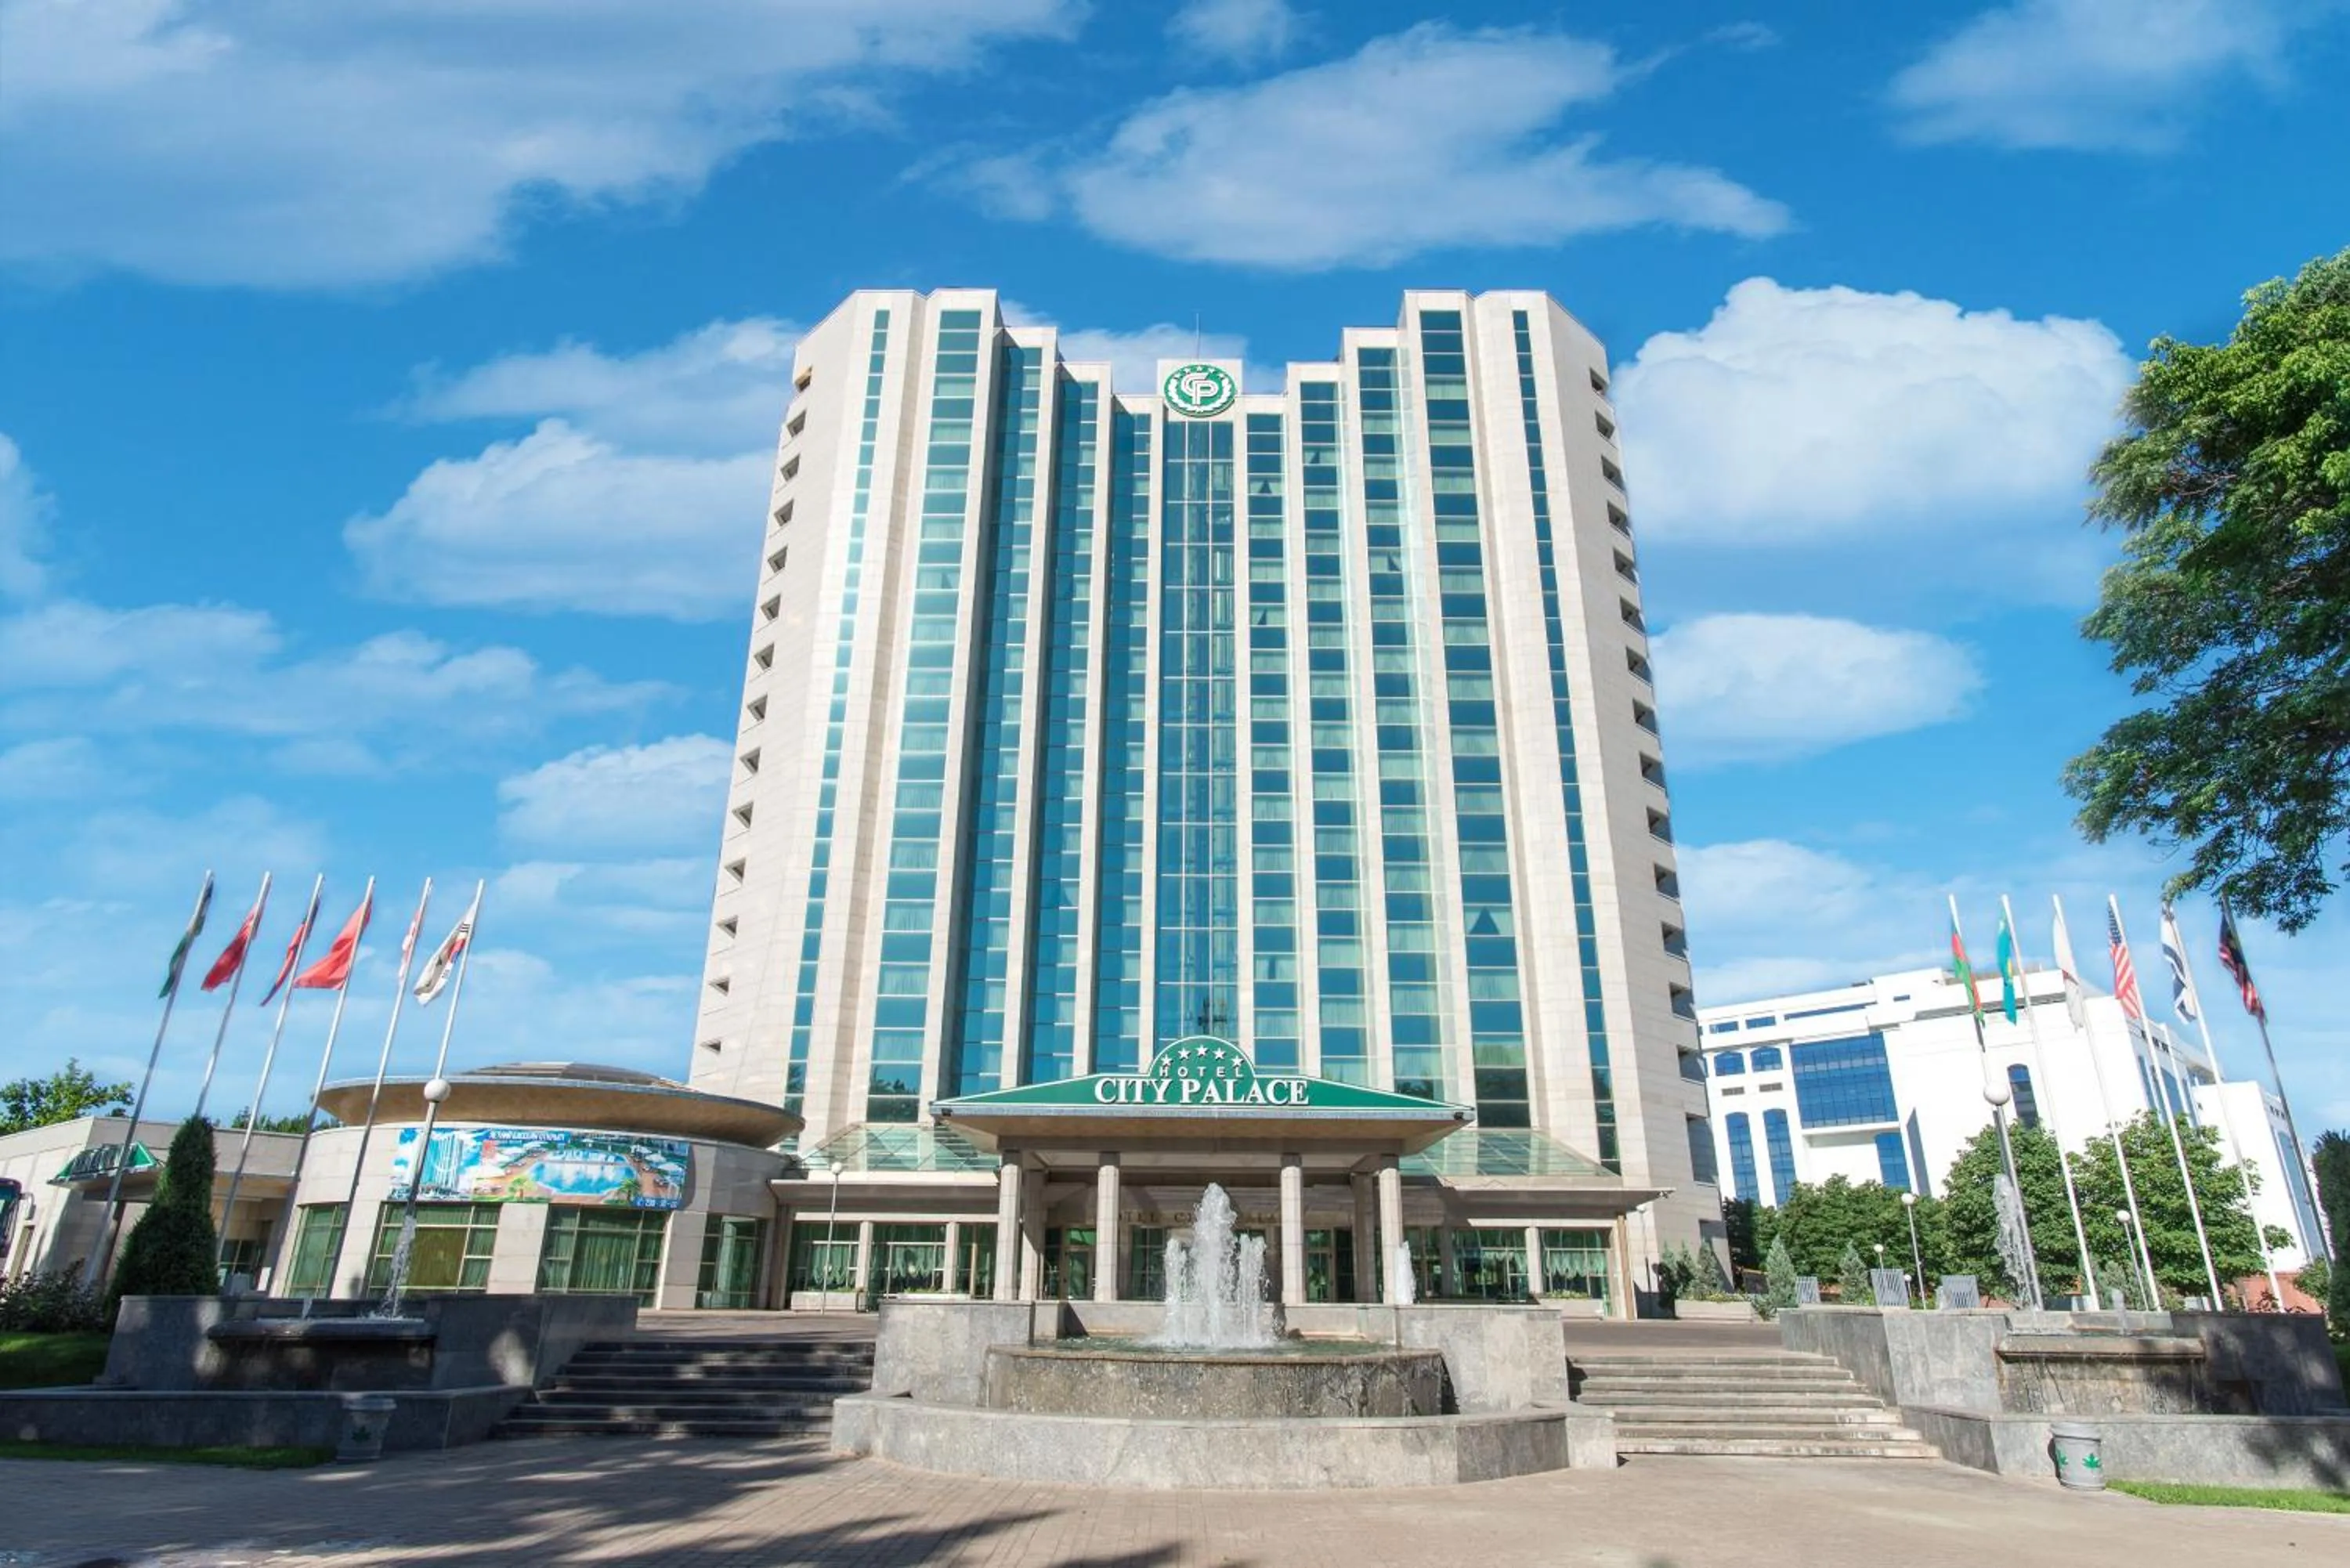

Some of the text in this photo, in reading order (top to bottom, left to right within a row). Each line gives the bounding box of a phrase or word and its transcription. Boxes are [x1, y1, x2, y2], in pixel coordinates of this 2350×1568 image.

[1159, 1066, 1244, 1078] HOTEL
[1094, 1078, 1309, 1104] CITY PALACE
